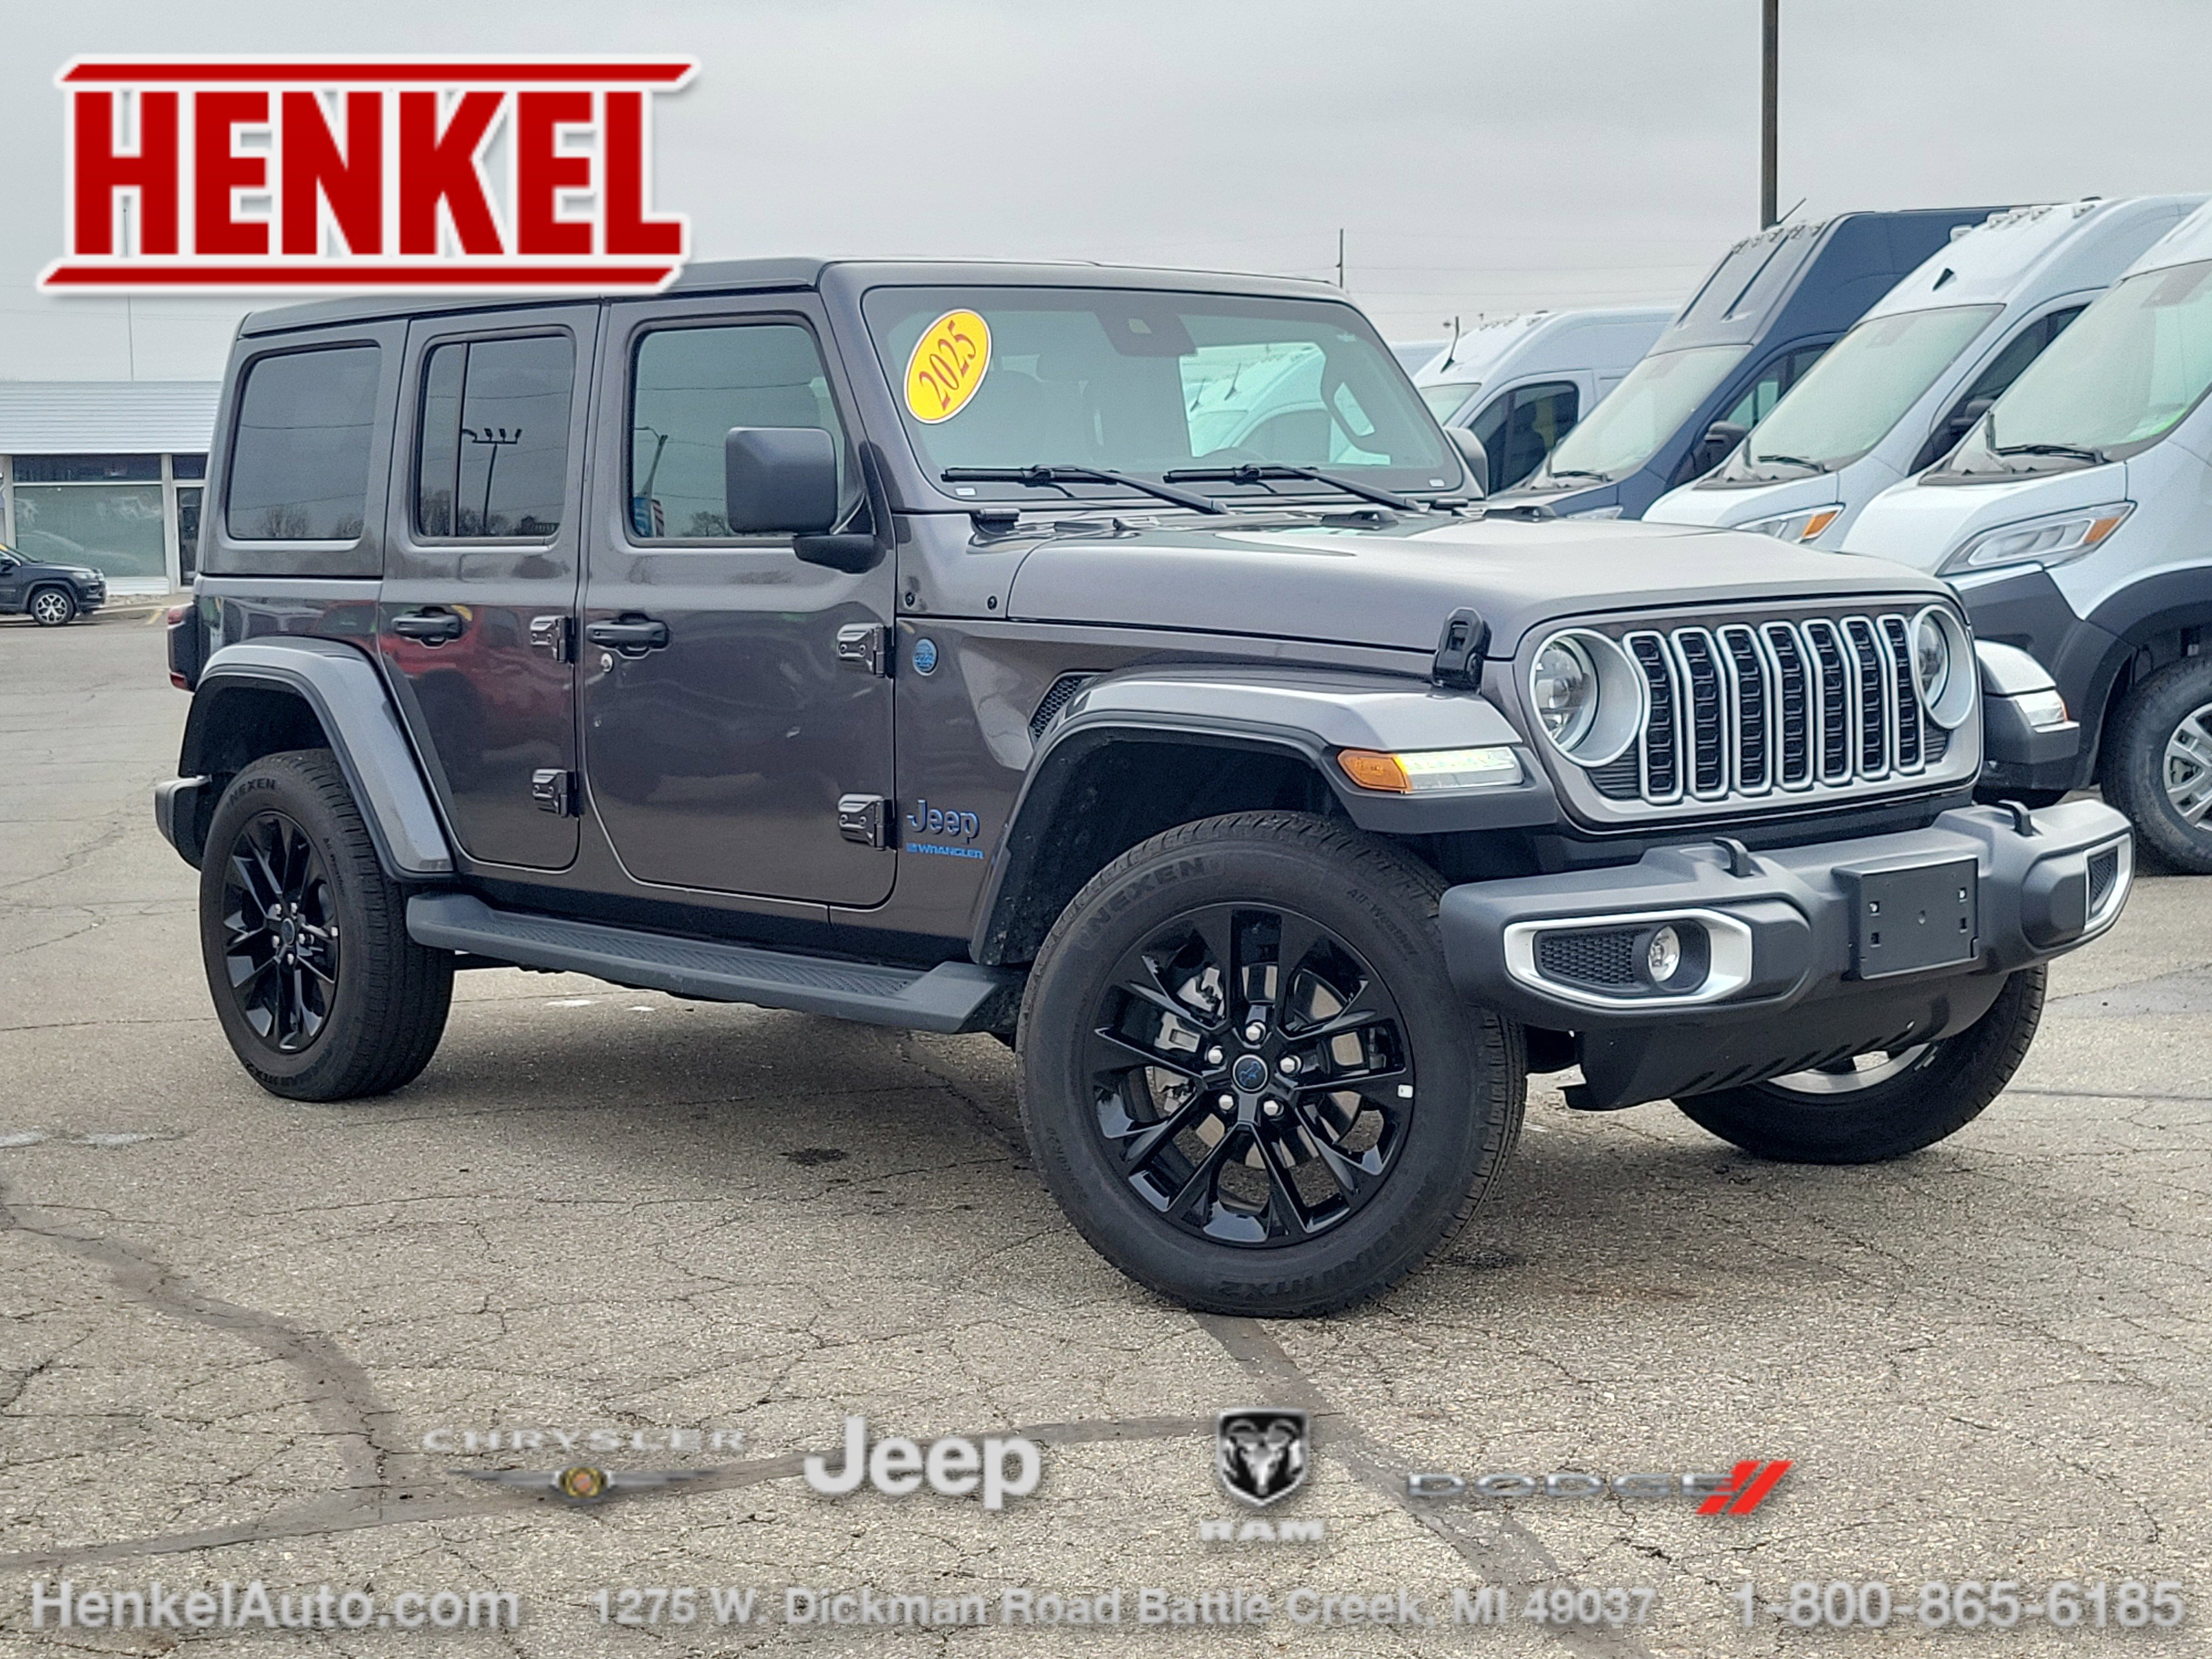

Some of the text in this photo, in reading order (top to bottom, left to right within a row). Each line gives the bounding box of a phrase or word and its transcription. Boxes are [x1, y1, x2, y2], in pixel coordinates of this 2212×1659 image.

[918, 320, 976, 411] 2025
[906, 798, 980, 844] Jeep
[1087, 857, 1205, 933] NEXEN
